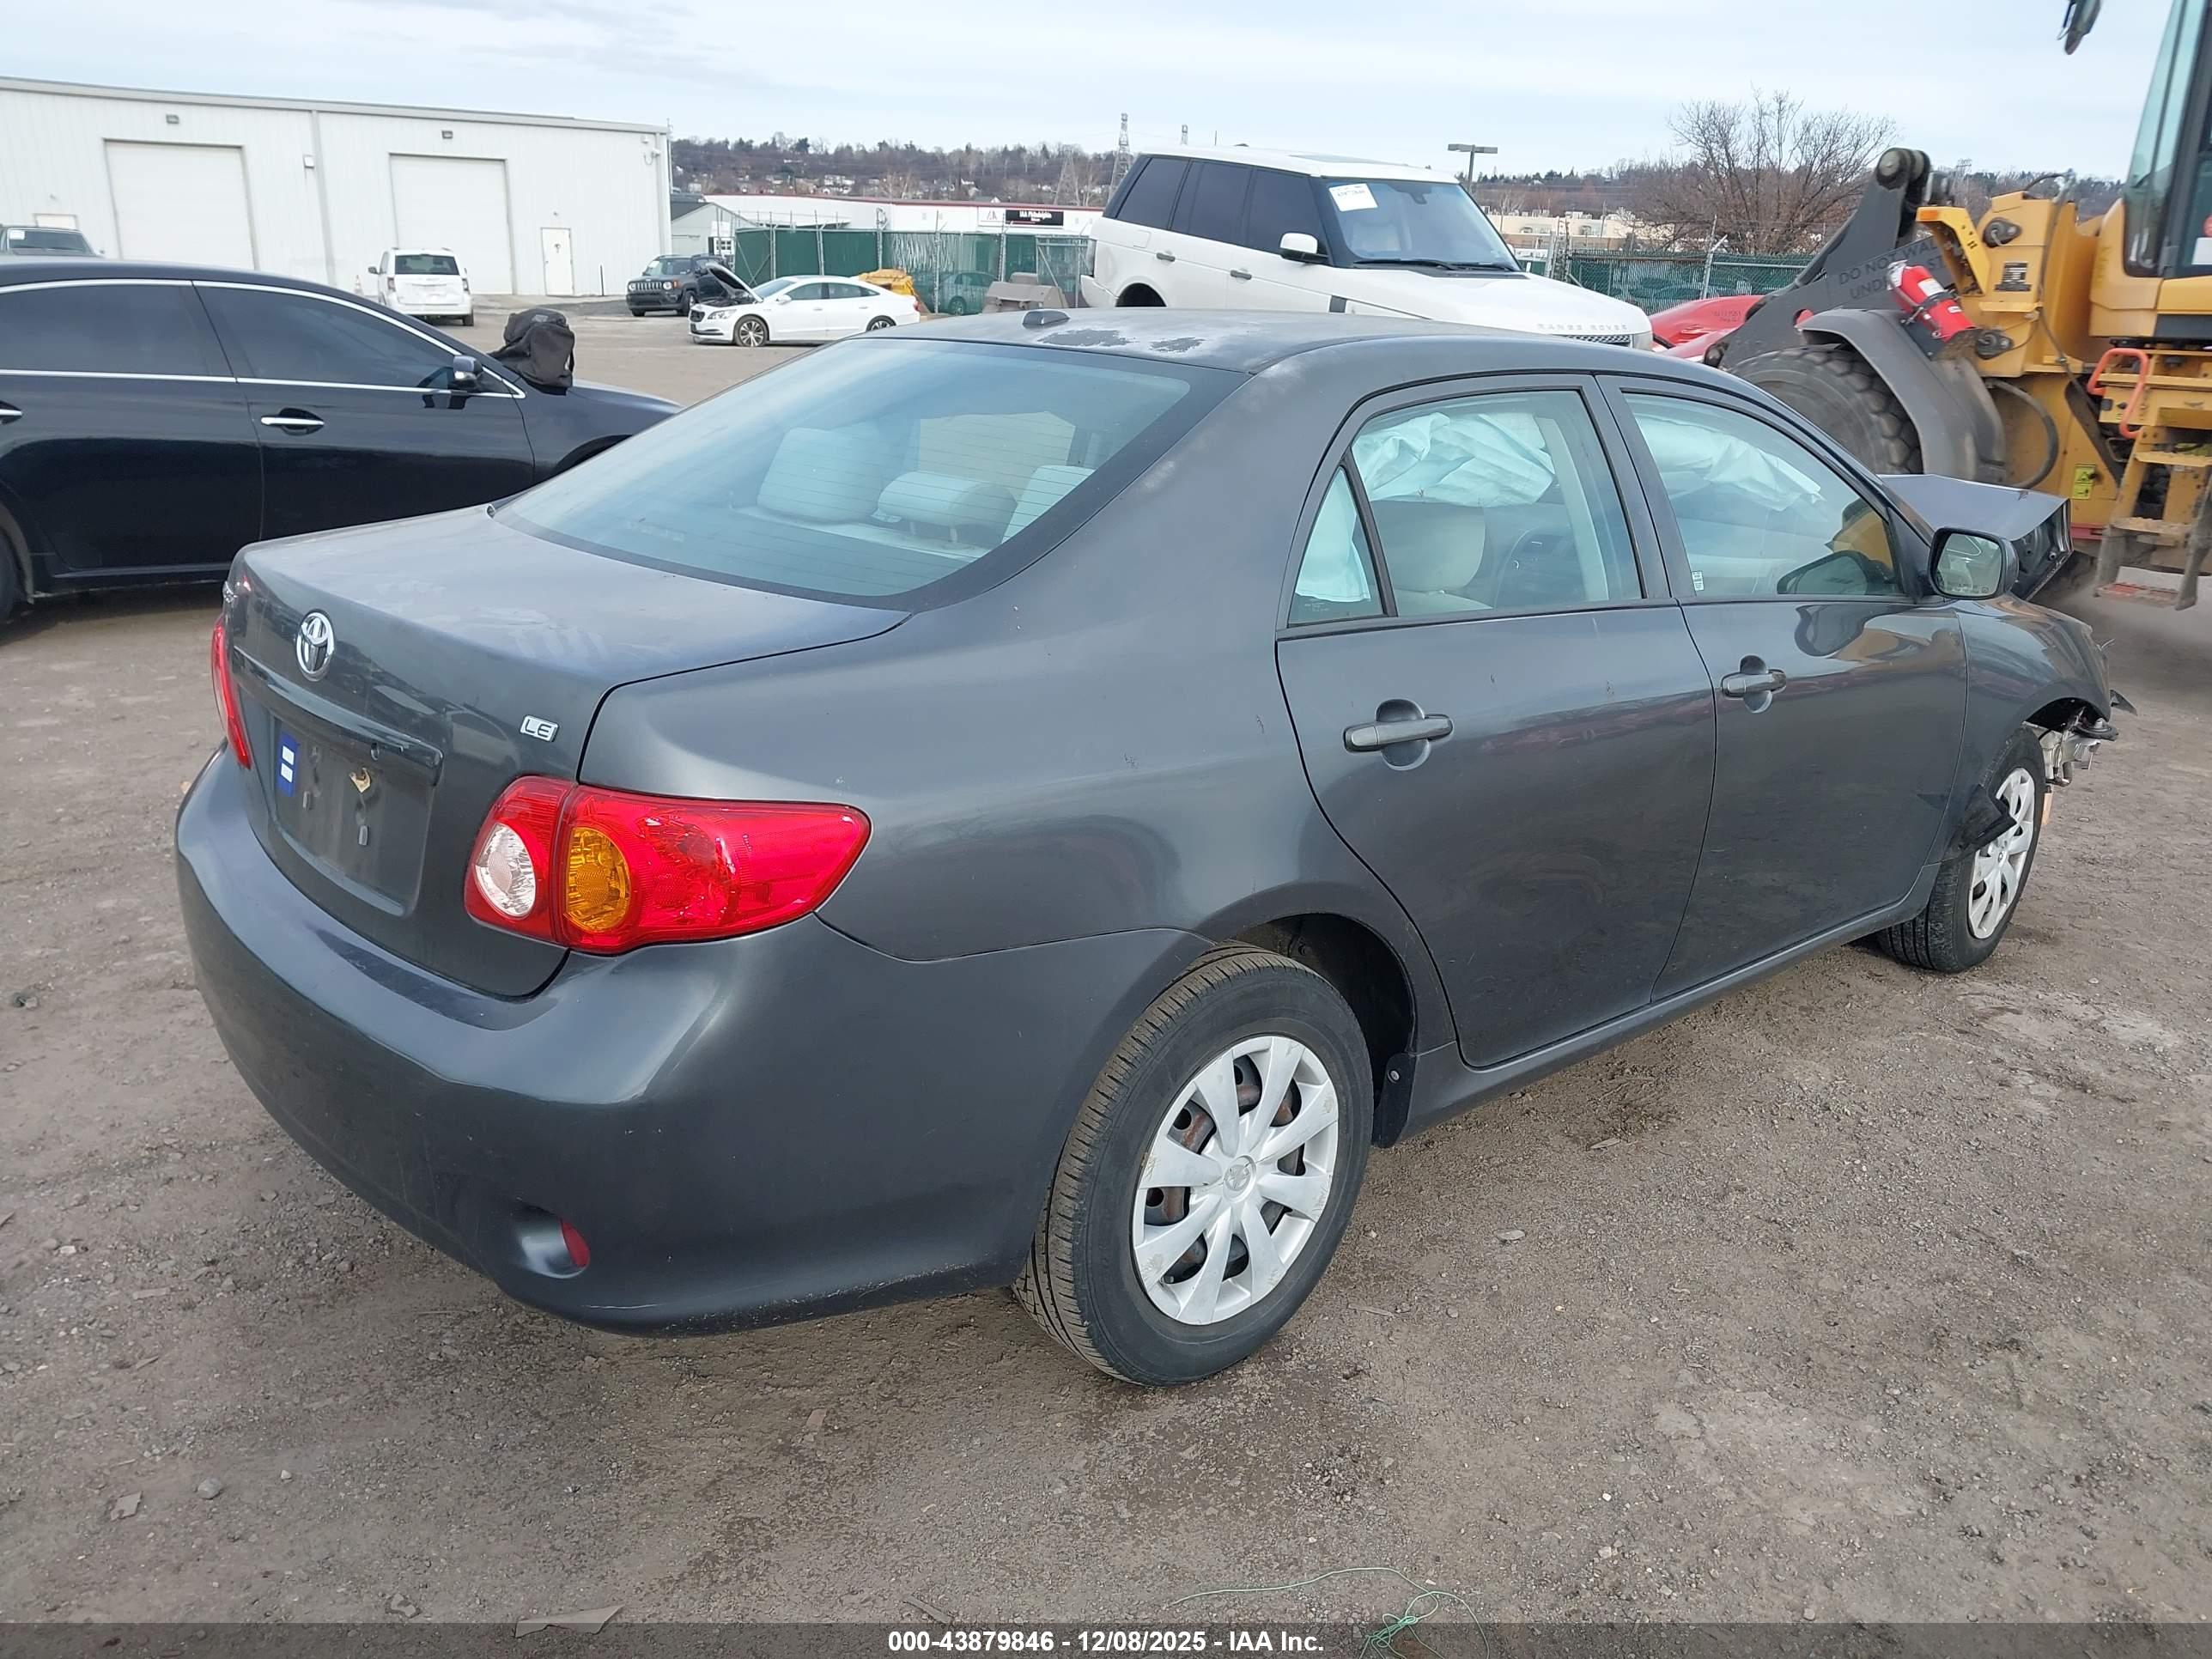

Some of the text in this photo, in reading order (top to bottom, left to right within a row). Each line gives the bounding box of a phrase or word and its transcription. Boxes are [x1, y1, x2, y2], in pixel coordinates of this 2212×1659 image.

[1839, 240, 1937, 284] DO NOT WAL
[525, 719, 552, 738] LE
